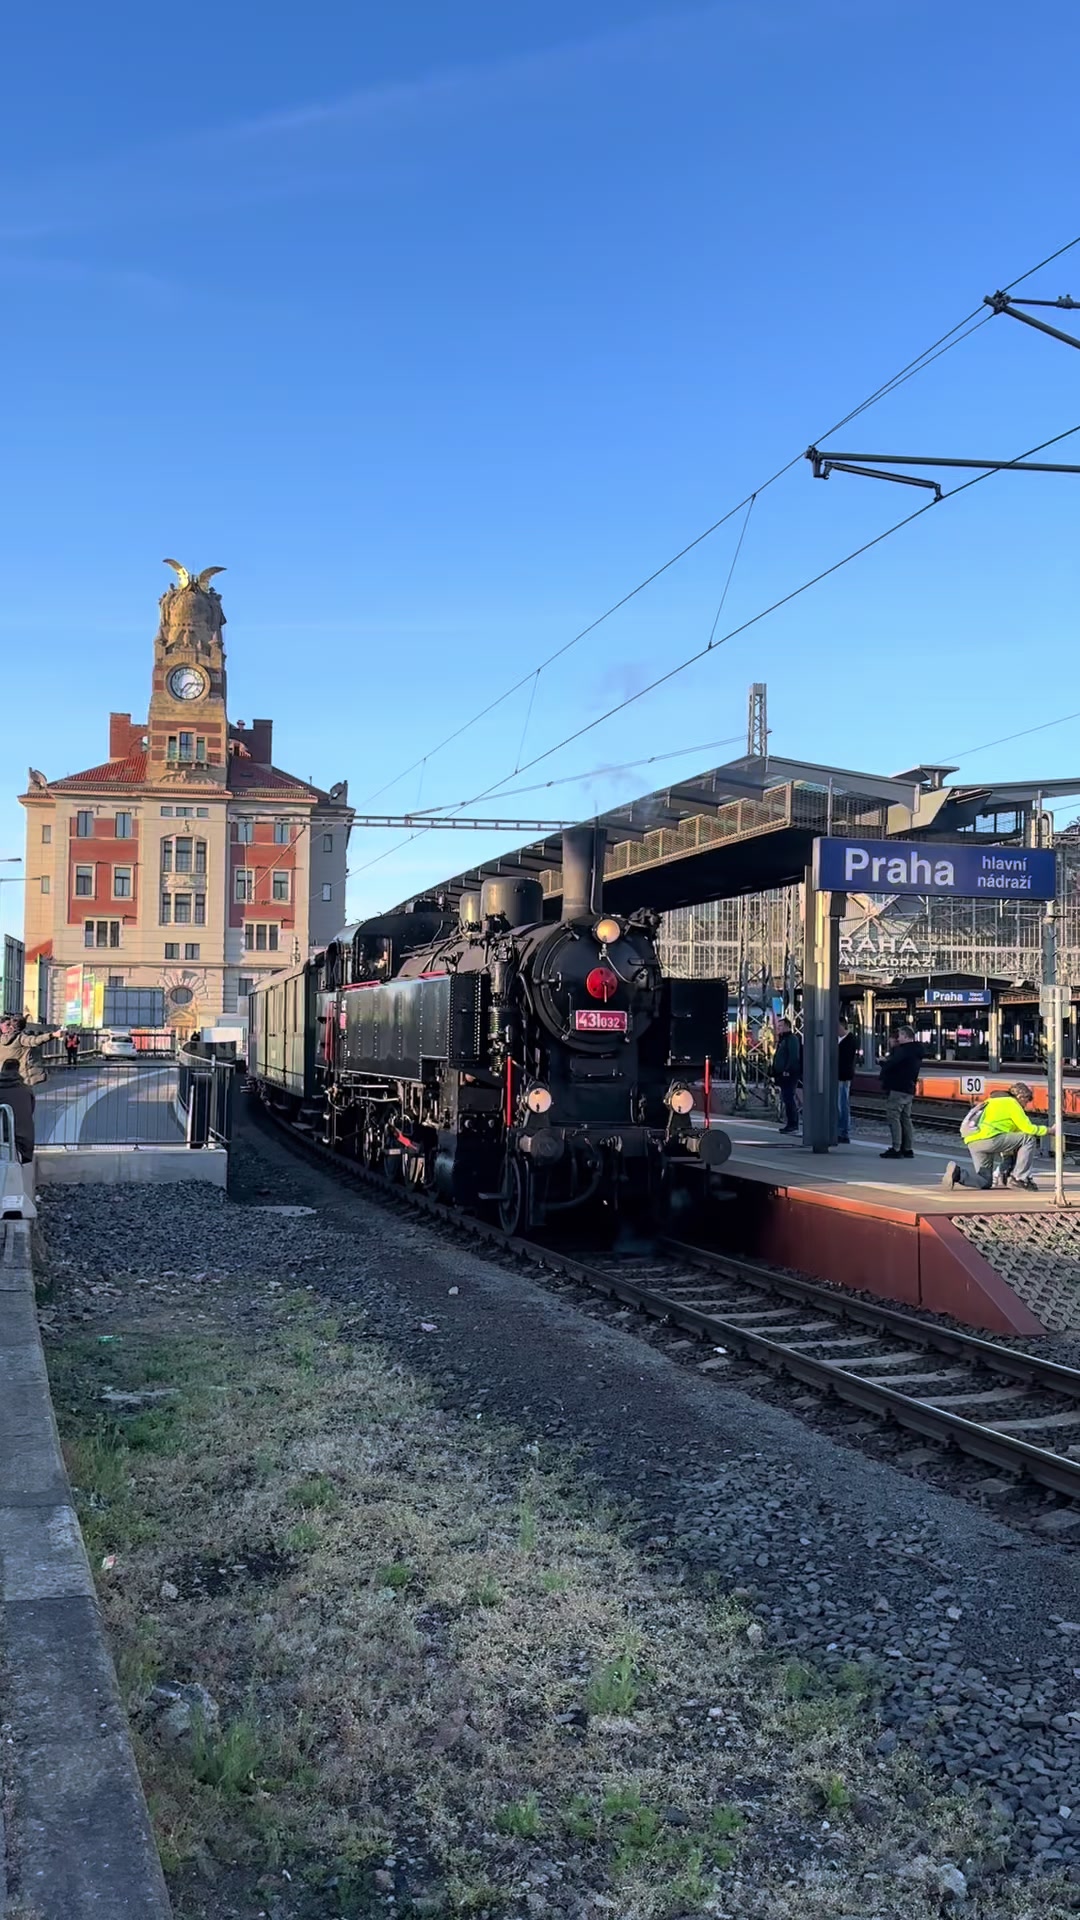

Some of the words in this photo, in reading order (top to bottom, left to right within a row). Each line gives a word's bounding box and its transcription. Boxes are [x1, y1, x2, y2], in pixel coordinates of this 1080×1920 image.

[845, 847, 955, 887] Praha
[982, 855, 1027, 872] hlavní
[977, 874, 1032, 890] nádraží
[839, 936, 919, 954] RAHA
[933, 991, 964, 1002] Praha
[967, 1078, 982, 1093] 50
